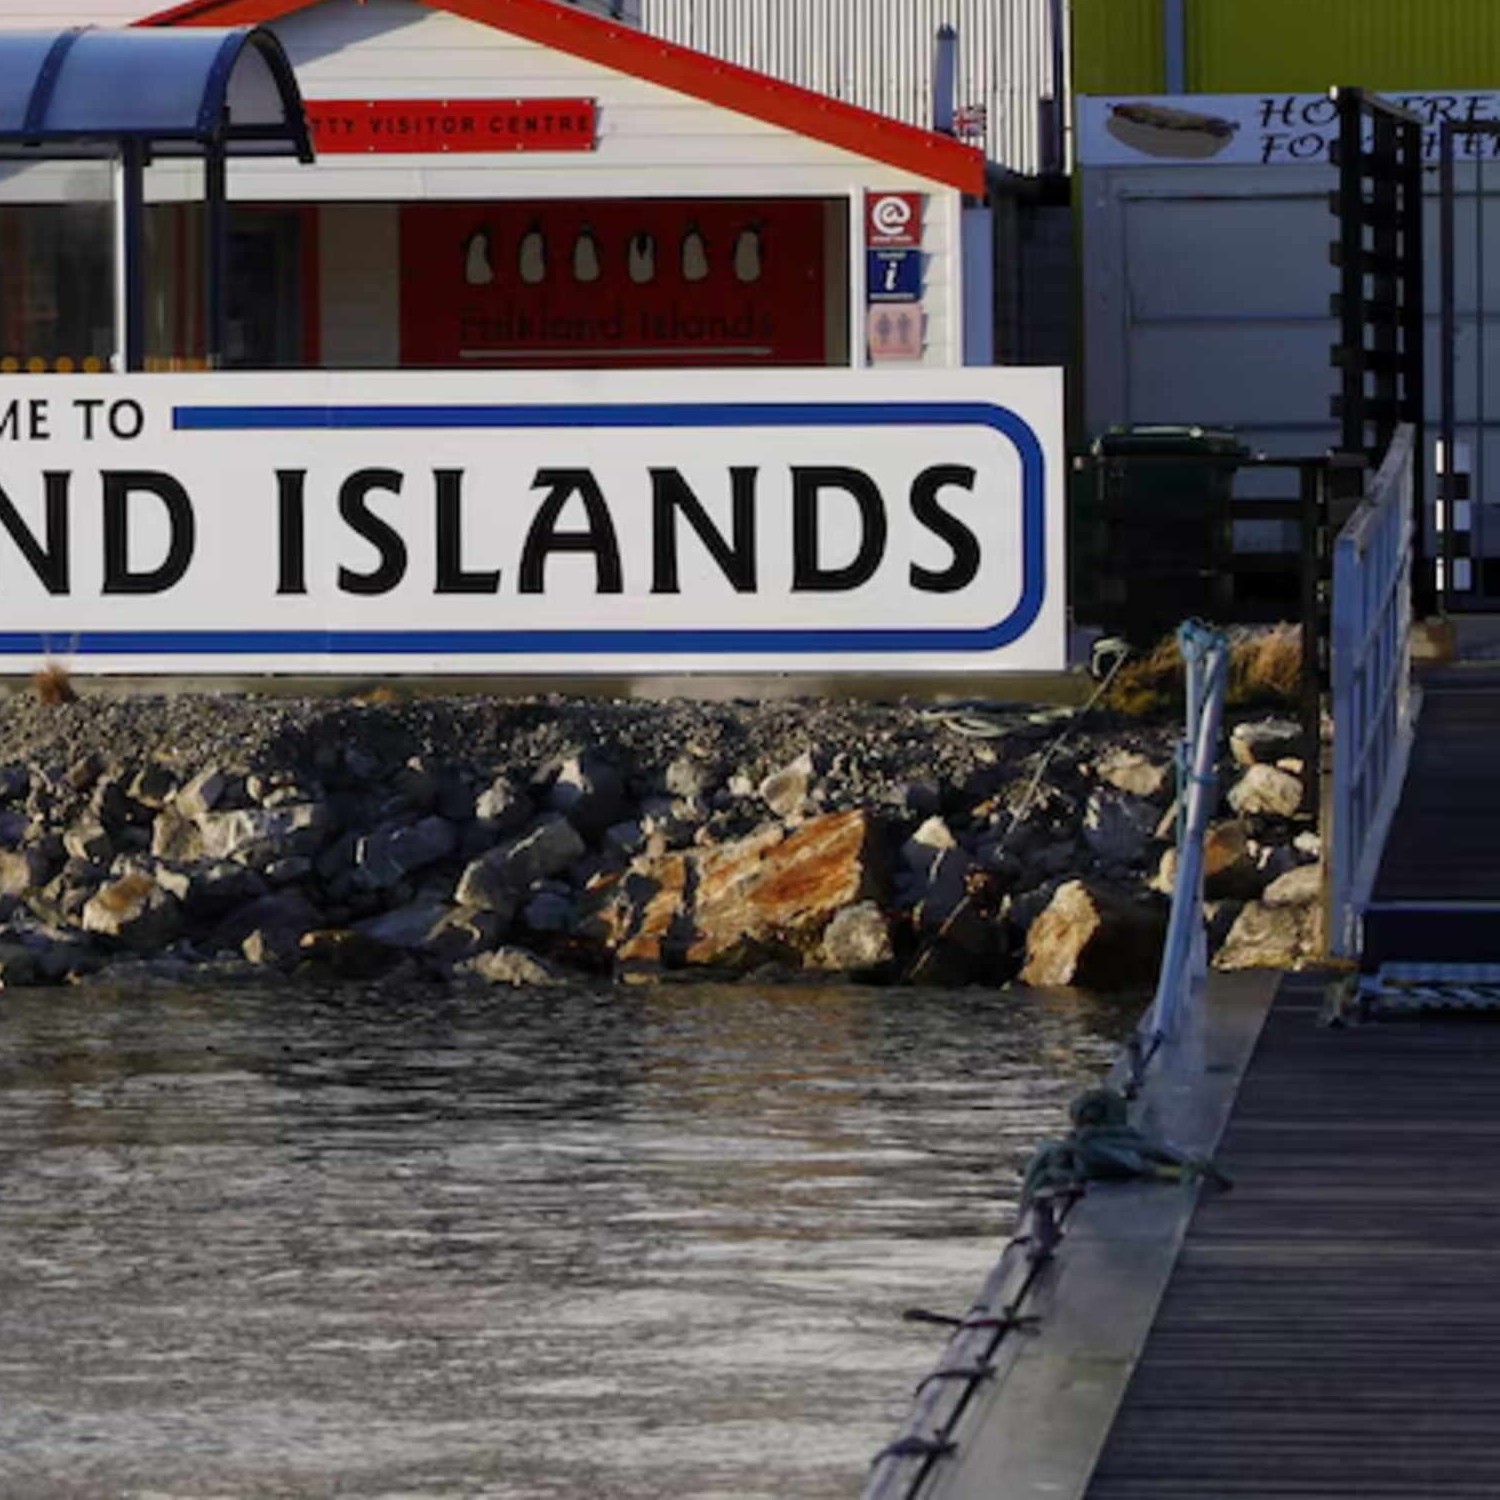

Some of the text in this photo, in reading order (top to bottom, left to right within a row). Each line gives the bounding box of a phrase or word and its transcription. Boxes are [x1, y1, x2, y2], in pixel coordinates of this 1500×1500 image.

[311, 114, 590, 134] TTY VISITOR CENTRE
[1259, 96, 1497, 127] HO FRE
[73, 399, 145, 440] TO
[274, 464, 982, 596] ISLANDS
